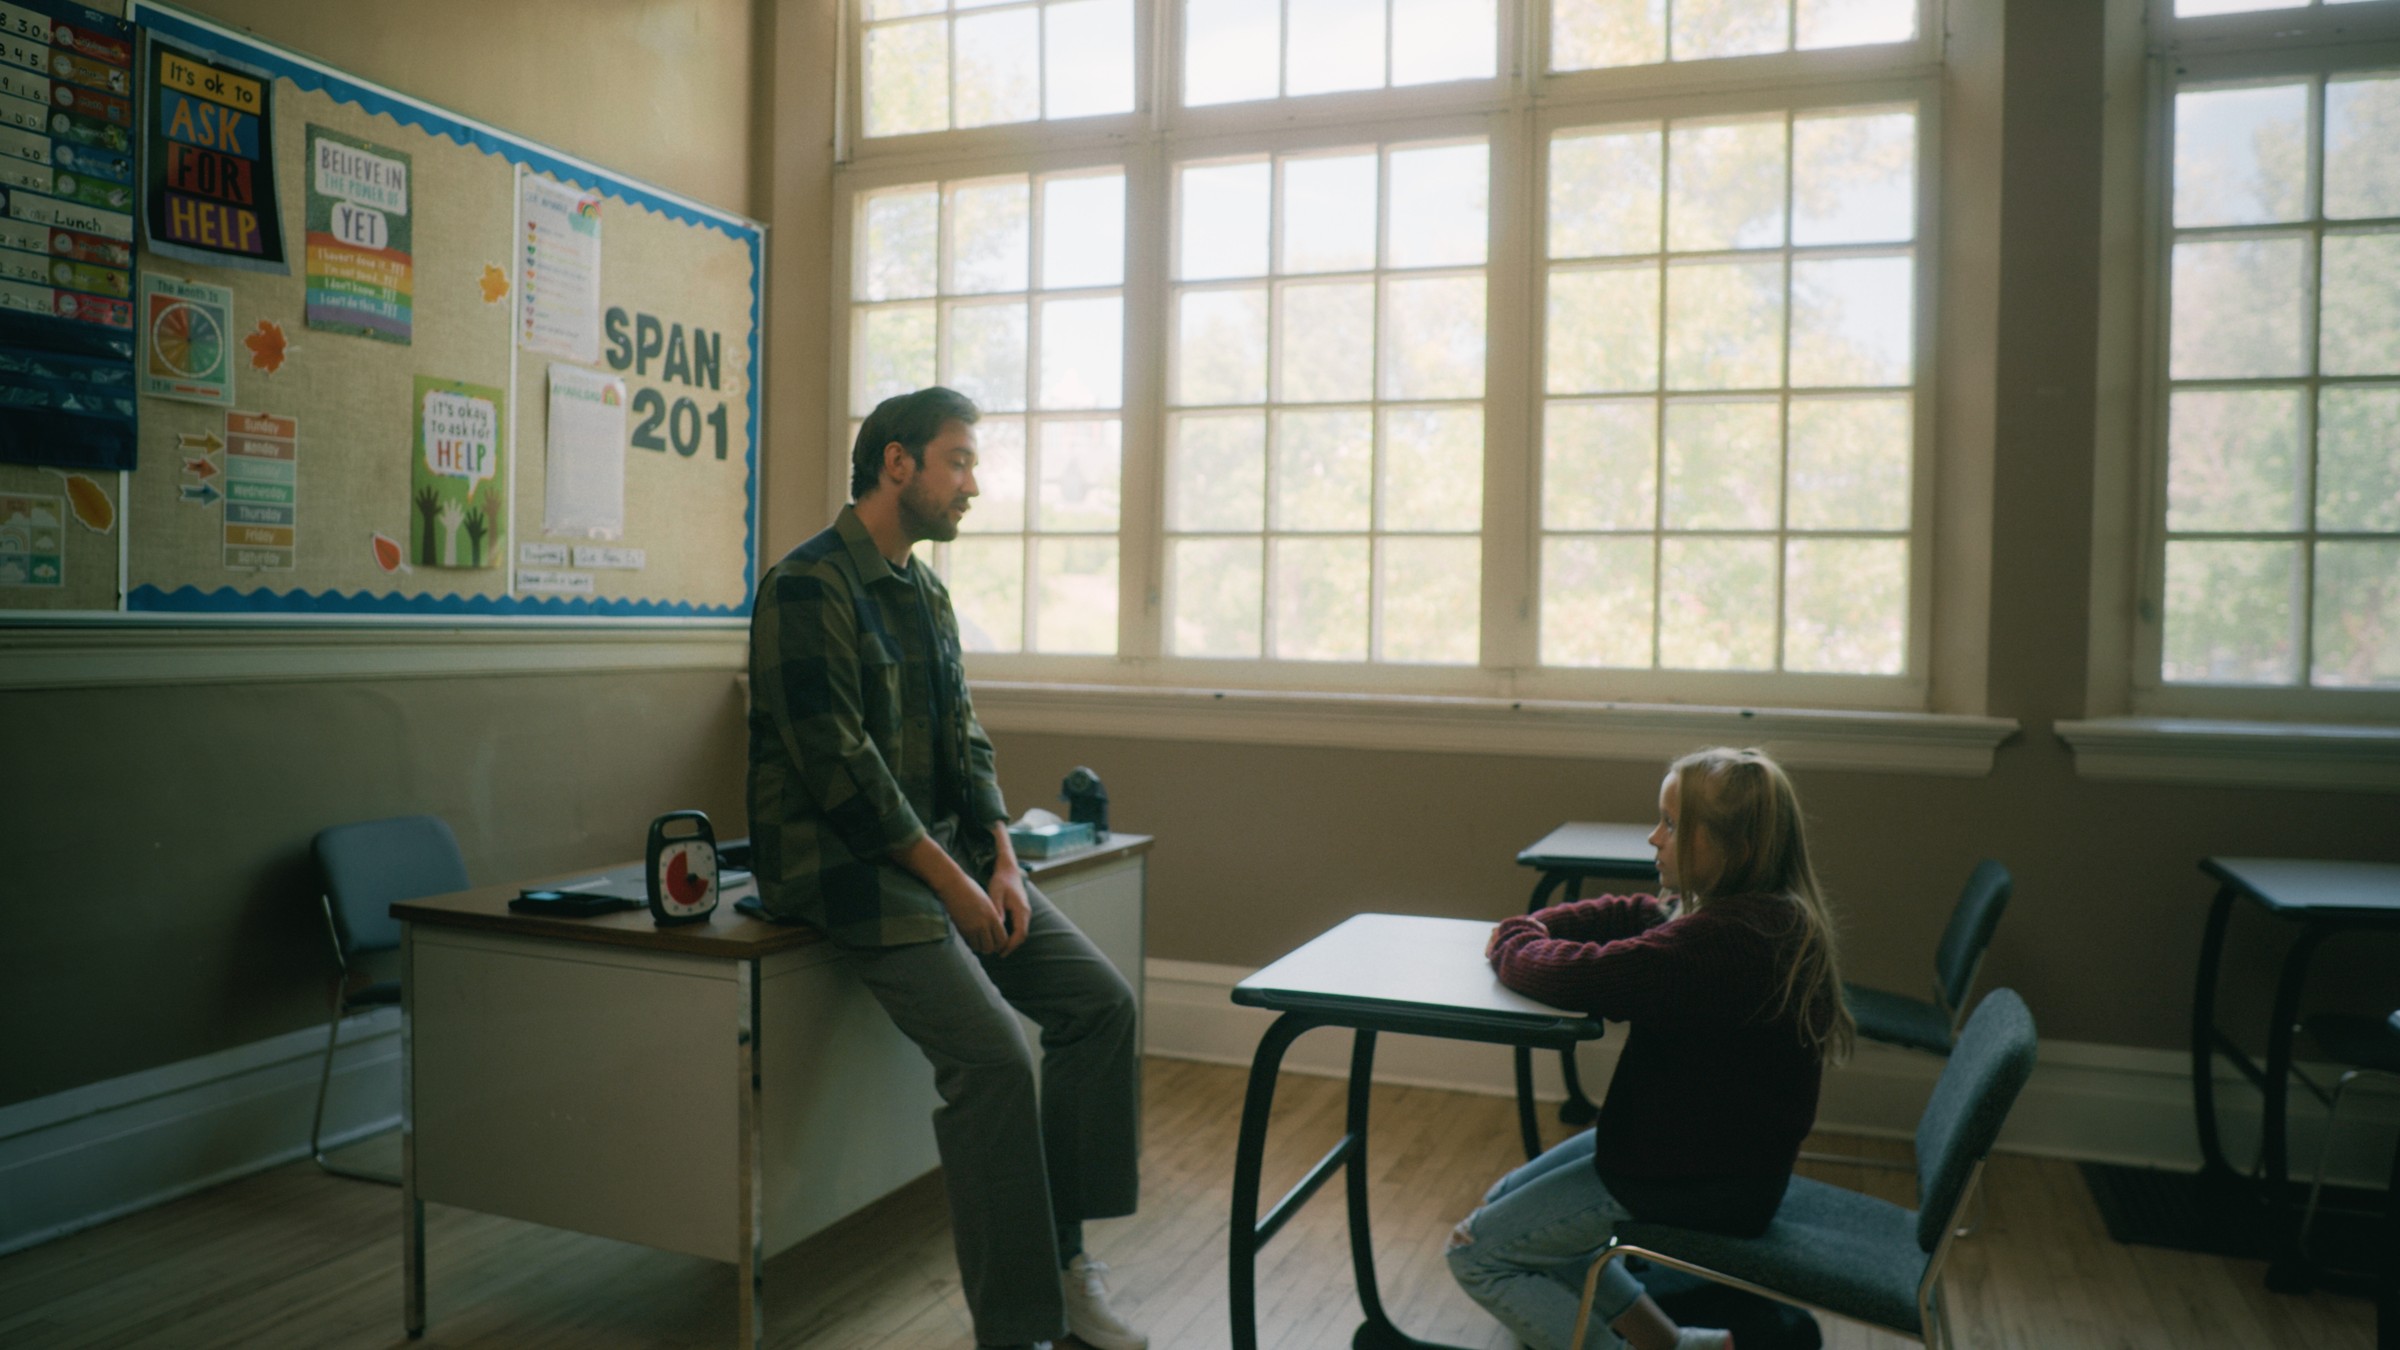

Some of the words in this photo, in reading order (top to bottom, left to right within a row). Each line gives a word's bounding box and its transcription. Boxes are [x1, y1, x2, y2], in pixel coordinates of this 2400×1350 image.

[170, 62, 195, 86] It's
[204, 74, 224, 95] ok
[235, 86, 254, 103] to
[169, 97, 242, 154] ASK
[178, 146, 243, 200] FOR
[321, 145, 381, 184] BELIEVE
[386, 166, 402, 190] IN
[323, 172, 345, 192] THE
[349, 179, 385, 203] POWER
[387, 190, 399, 207] OF
[54, 209, 102, 232] Lunch
[171, 197, 257, 251] HELP
[341, 207, 377, 245] YET
[158, 280, 174, 294] The
[177, 284, 207, 301] Month
[604, 306, 721, 391] SPAN
[243, 418, 280, 435] Sunday
[432, 419, 446, 434] to
[448, 420, 468, 437] ask
[471, 423, 491, 439] for
[458, 402, 488, 428] okay
[631, 387, 728, 460] 201
[243, 440, 280, 457] Monday
[437, 440, 487, 473] HELP
[233, 483, 288, 501] Wednesday
[239, 506, 282, 523] Thursday
[244, 528, 275, 544] Friday
[238, 550, 280, 566] Saturday
